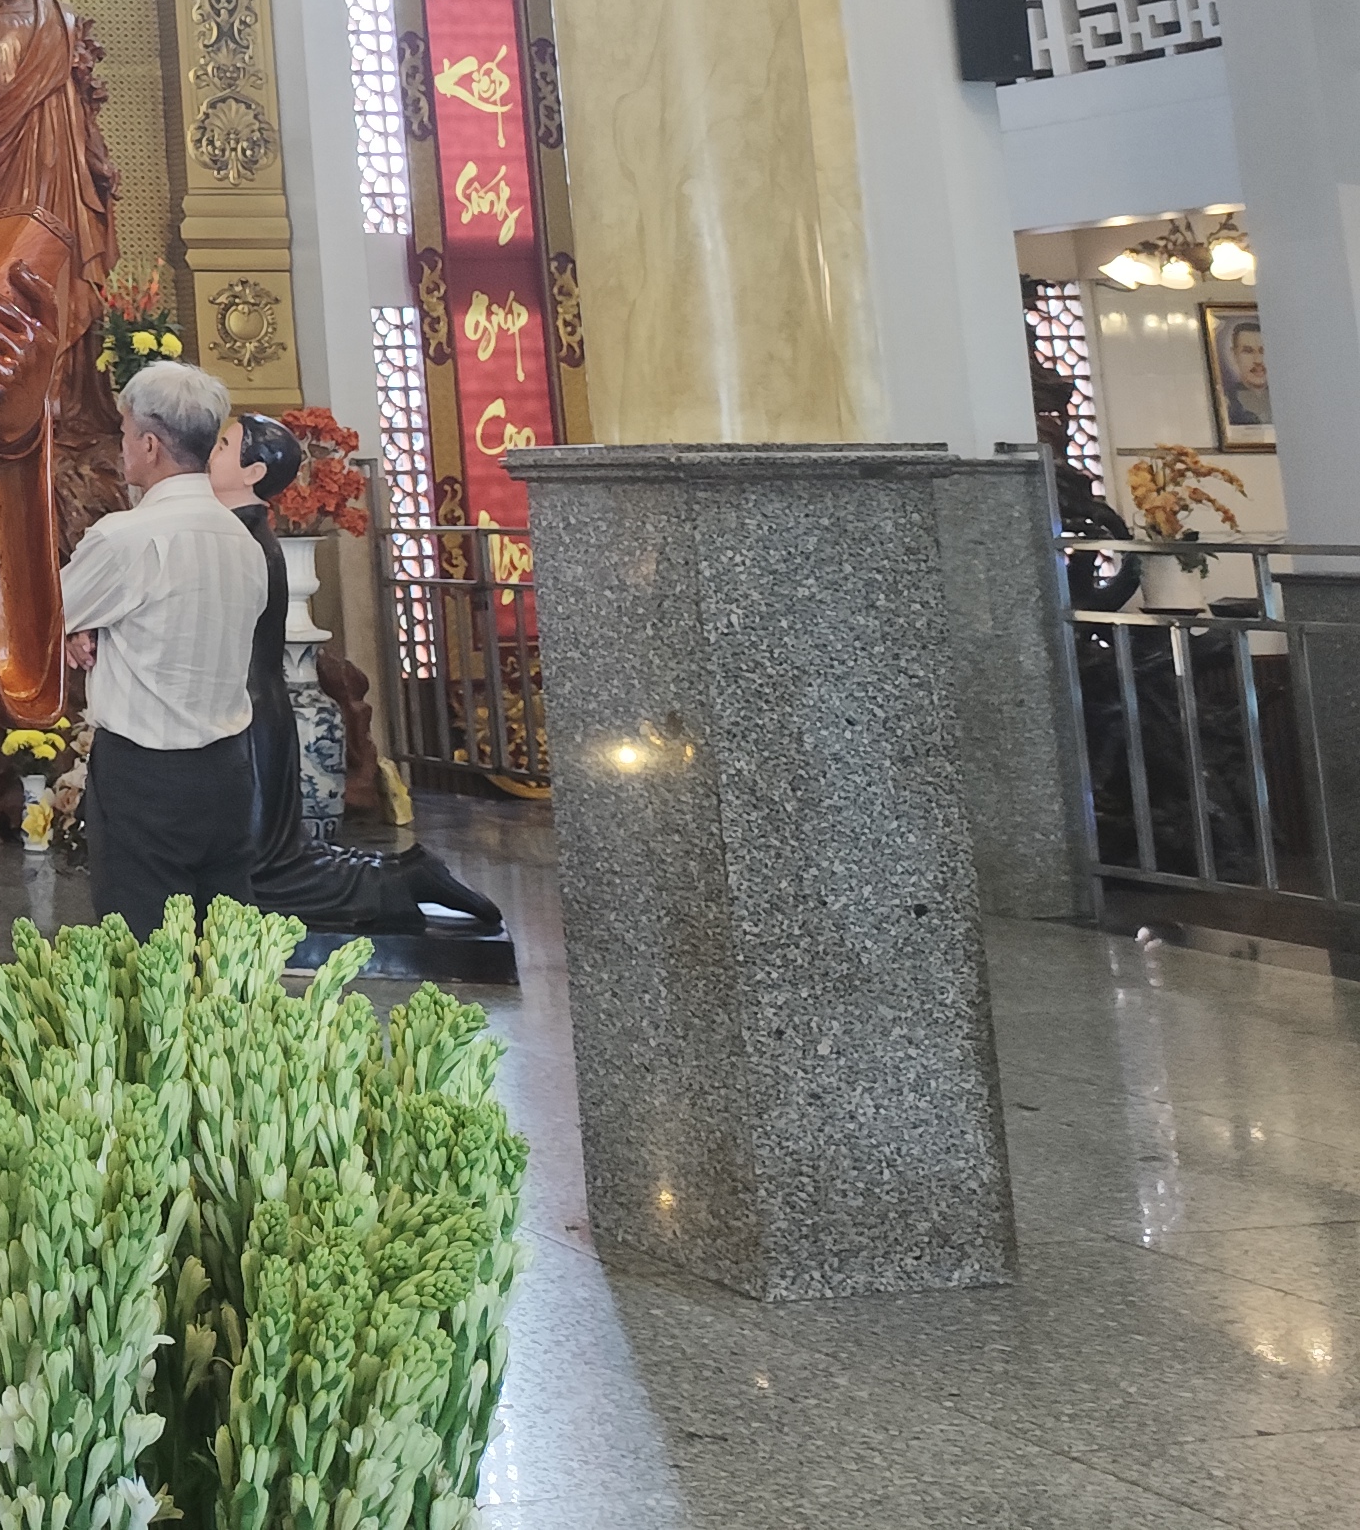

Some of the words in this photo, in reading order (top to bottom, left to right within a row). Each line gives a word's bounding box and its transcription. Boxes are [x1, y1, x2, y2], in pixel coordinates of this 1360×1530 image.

[435, 45, 514, 148] Kiếp
[455, 161, 524, 245] Sống
[464, 290, 529, 382] Giúp
